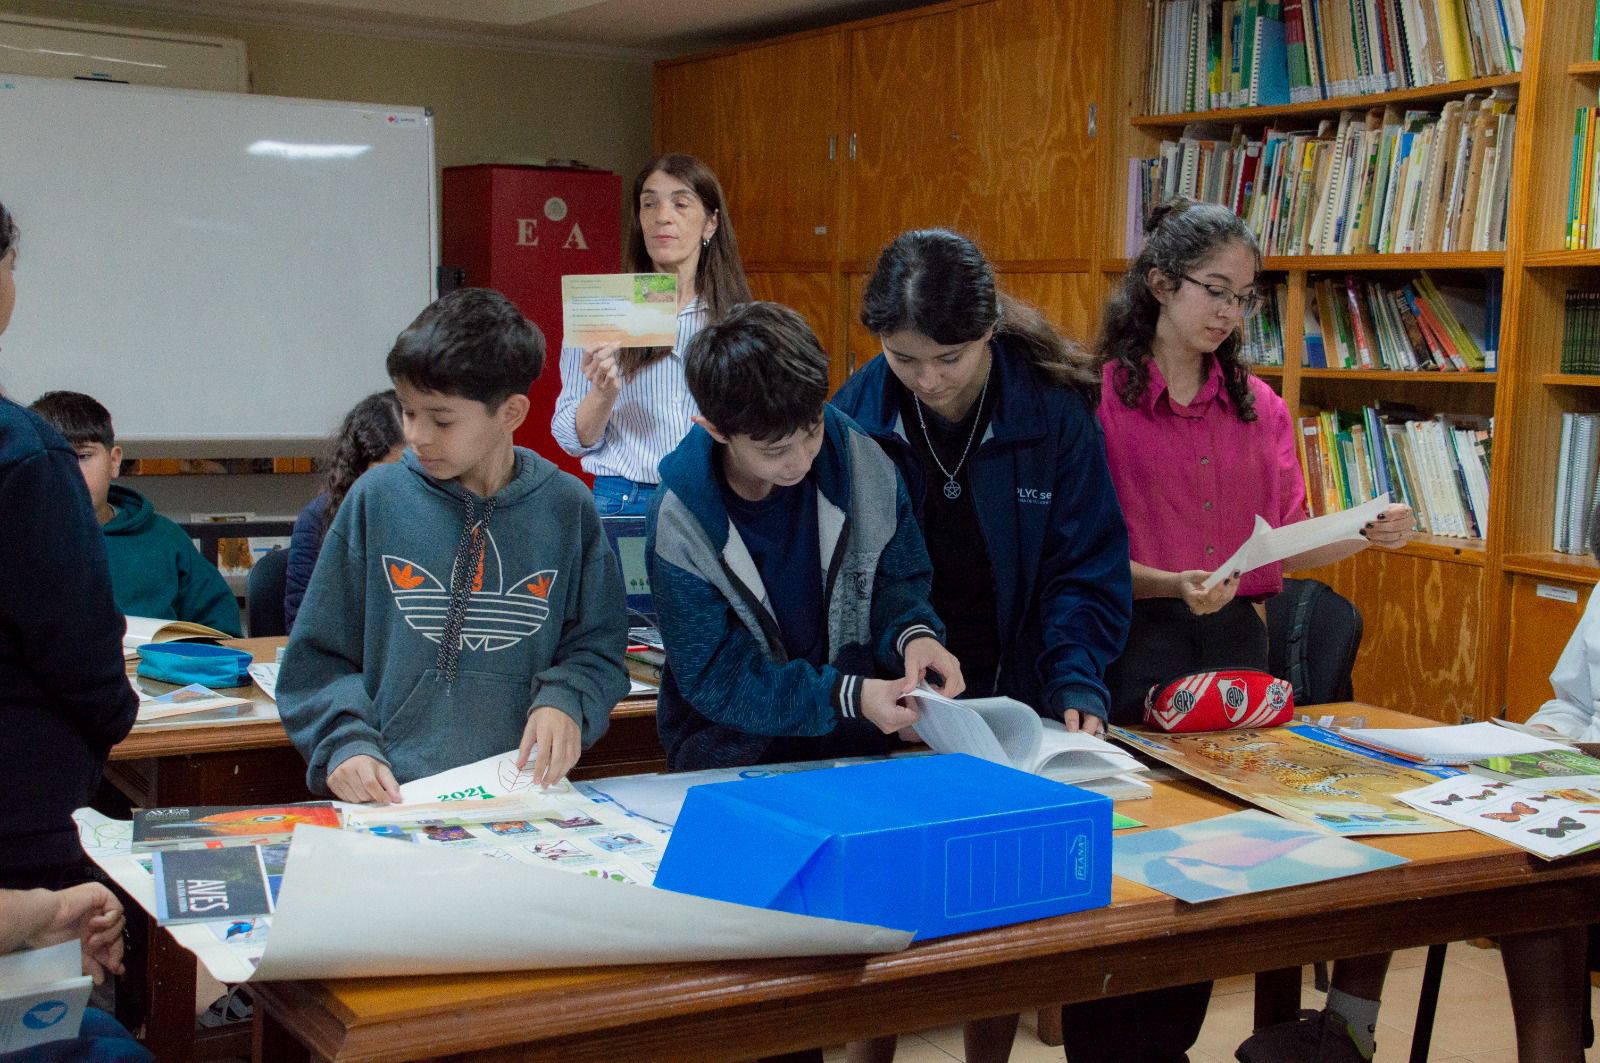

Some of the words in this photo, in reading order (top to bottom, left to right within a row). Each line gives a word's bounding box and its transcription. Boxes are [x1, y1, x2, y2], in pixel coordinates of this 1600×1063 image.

[516, 218, 539, 247] E
[562, 222, 590, 250] A
[436, 785, 487, 802] 2021
[187, 879, 230, 912] AVES
